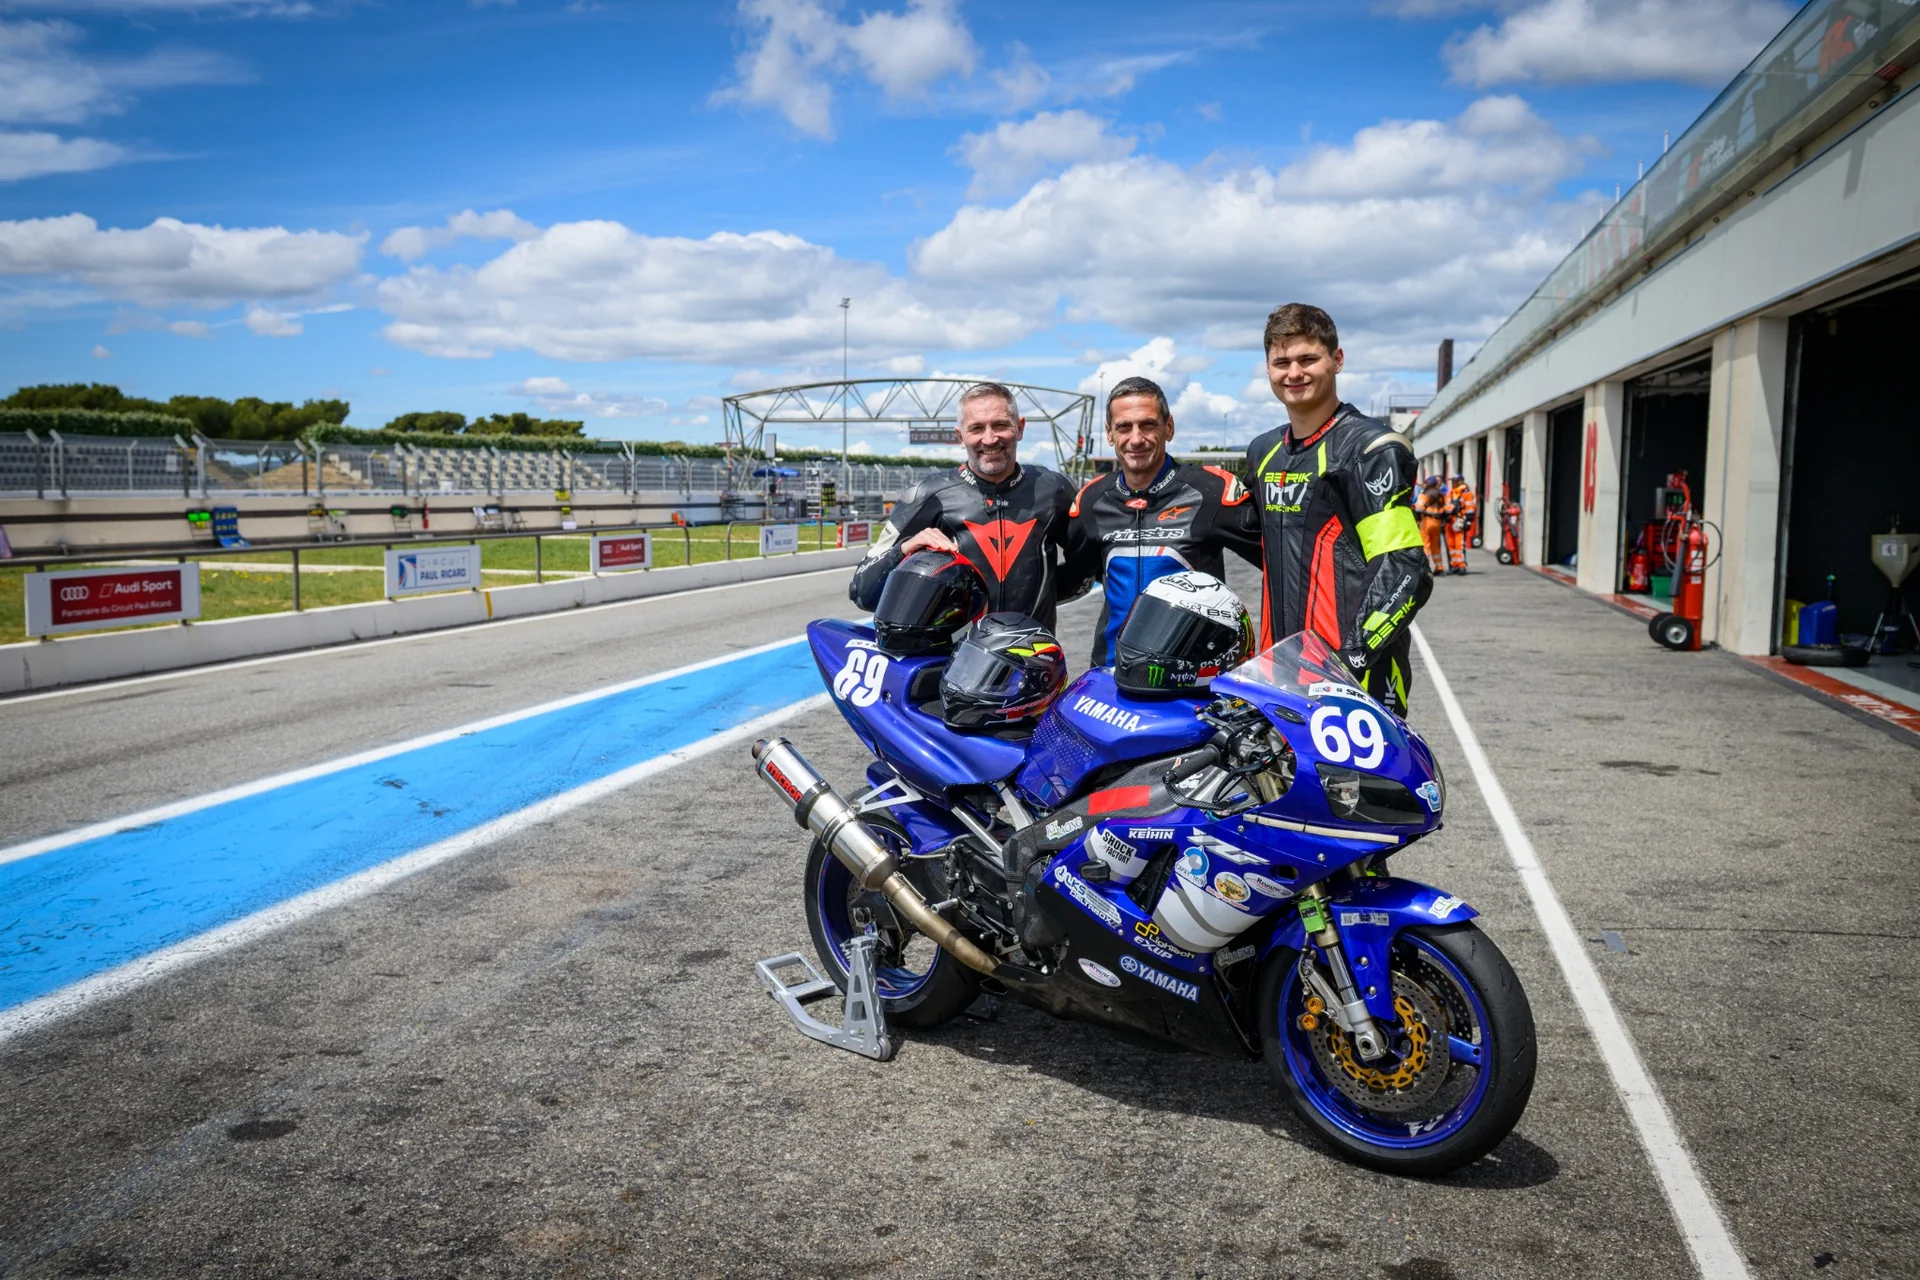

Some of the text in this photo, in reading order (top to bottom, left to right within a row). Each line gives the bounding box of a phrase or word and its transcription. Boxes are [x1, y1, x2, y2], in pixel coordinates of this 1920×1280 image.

[1265, 504, 1301, 512] RACING
[420, 557, 466, 568] CIRCUIT
[420, 568, 467, 580] PAUL RICARD
[114, 580, 173, 594] Audi Sport
[61, 607, 100, 617] Partenaire
[100, 605, 110, 614] du
[111, 604, 134, 613] Circuit
[135, 602, 149, 610] Paul
[1207, 608, 1232, 618] BS
[1367, 595, 1416, 650] BERIK
[833, 649, 889, 707] 69
[1073, 695, 1140, 732] YAMAHA
[1310, 706, 1385, 769] 69
[1128, 827, 1175, 840] KEIHIN
[1102, 831, 1135, 858] SHOCK
[1105, 845, 1131, 865] FACTORY
[1133, 935, 1173, 960] EXUP
[1137, 964, 1199, 1001] YAMAHA
